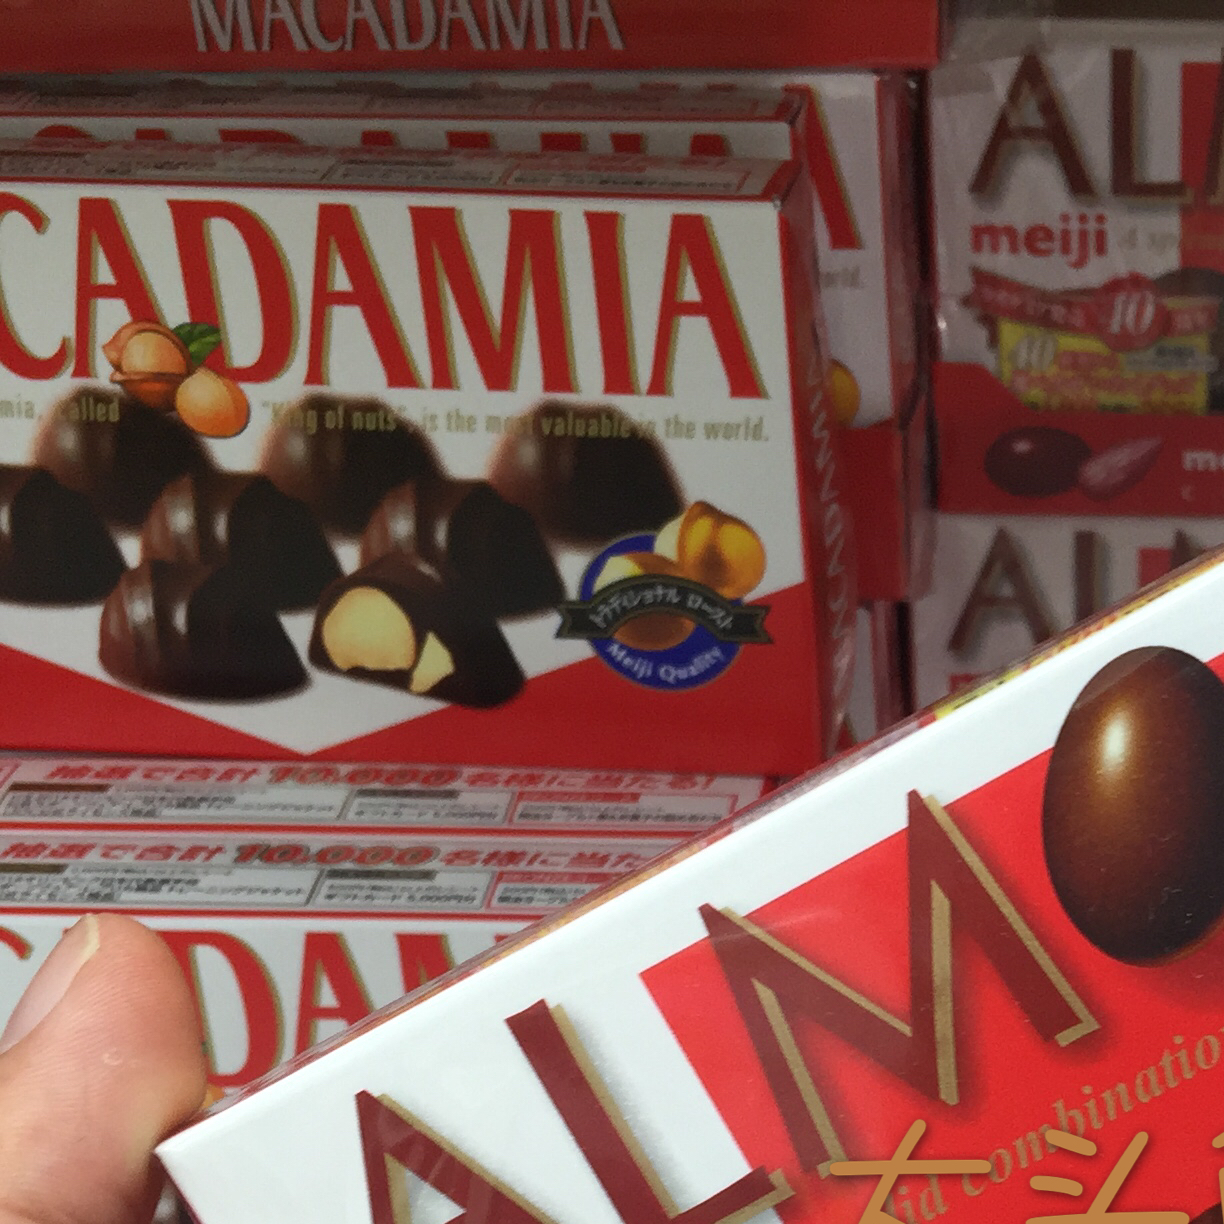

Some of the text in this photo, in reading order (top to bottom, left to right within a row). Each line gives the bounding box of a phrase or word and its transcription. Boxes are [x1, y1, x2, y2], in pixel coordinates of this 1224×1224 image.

[968, 212, 1109, 270] meiji
[324, 403, 345, 430] of
[445, 407, 477, 433] the
[541, 408, 631, 438] valuable
[664, 412, 696, 439] the
[702, 414, 770, 442] world.
[607, 642, 726, 685] Meiji Quality
